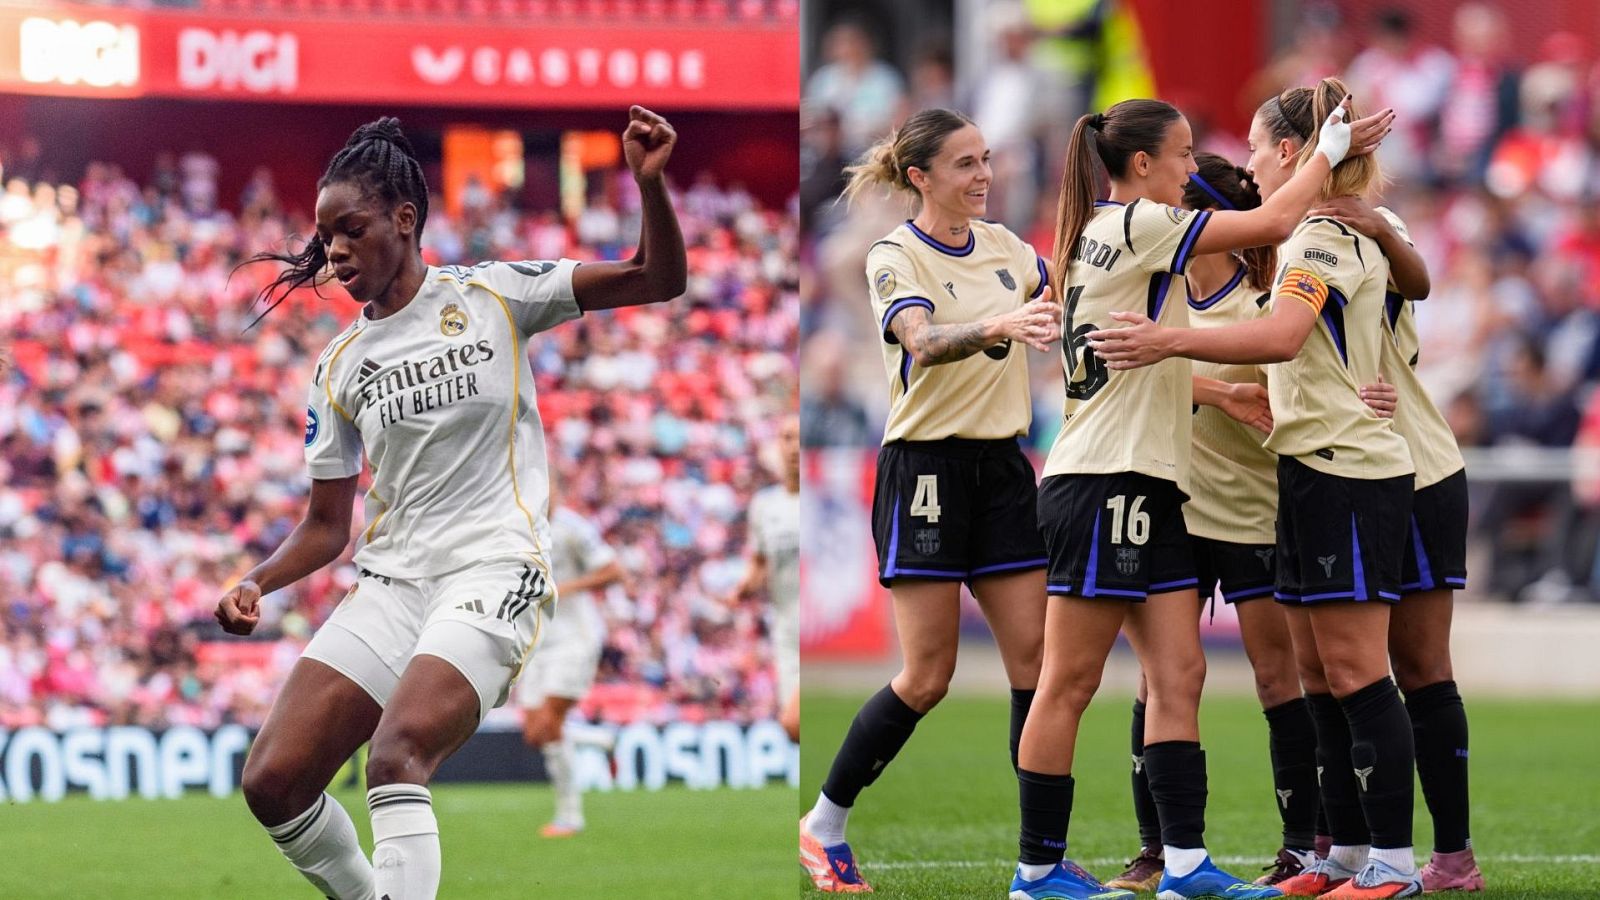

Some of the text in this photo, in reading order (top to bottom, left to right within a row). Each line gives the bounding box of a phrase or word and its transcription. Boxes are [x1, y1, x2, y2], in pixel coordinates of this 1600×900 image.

[19, 17, 139, 88] DIGI
[177, 27, 298, 94] DIGI
[470, 46, 704, 90] CASTORE
[1074, 236, 1122, 272] ORDI
[1304, 250, 1338, 265] BIMBO
[361, 339, 494, 410] Emirates
[379, 371, 479, 429] FLY BETTER
[910, 474, 942, 523] 4
[1106, 494, 1151, 546] 16
[0, 724, 250, 803] osner
